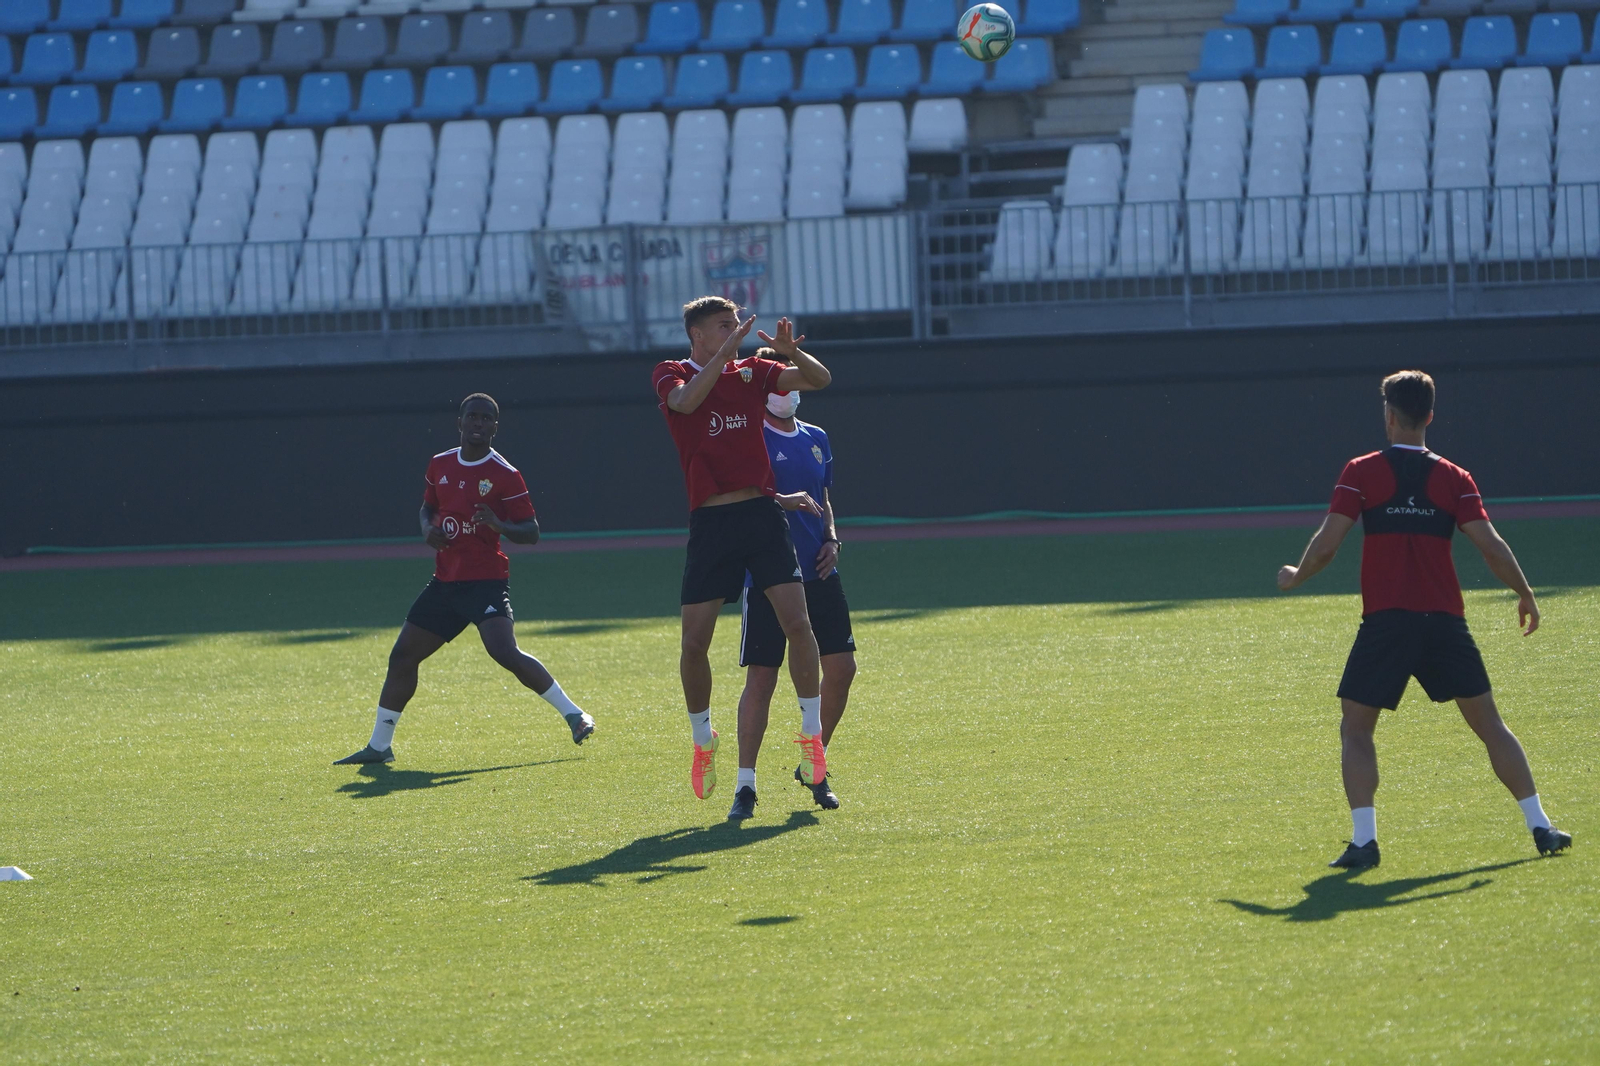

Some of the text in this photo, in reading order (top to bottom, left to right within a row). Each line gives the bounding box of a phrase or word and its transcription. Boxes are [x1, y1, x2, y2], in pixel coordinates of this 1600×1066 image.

[726, 420, 747, 430] NAFT
[1386, 506, 1436, 516] CATAPULT
[446, 522, 454, 532] N
